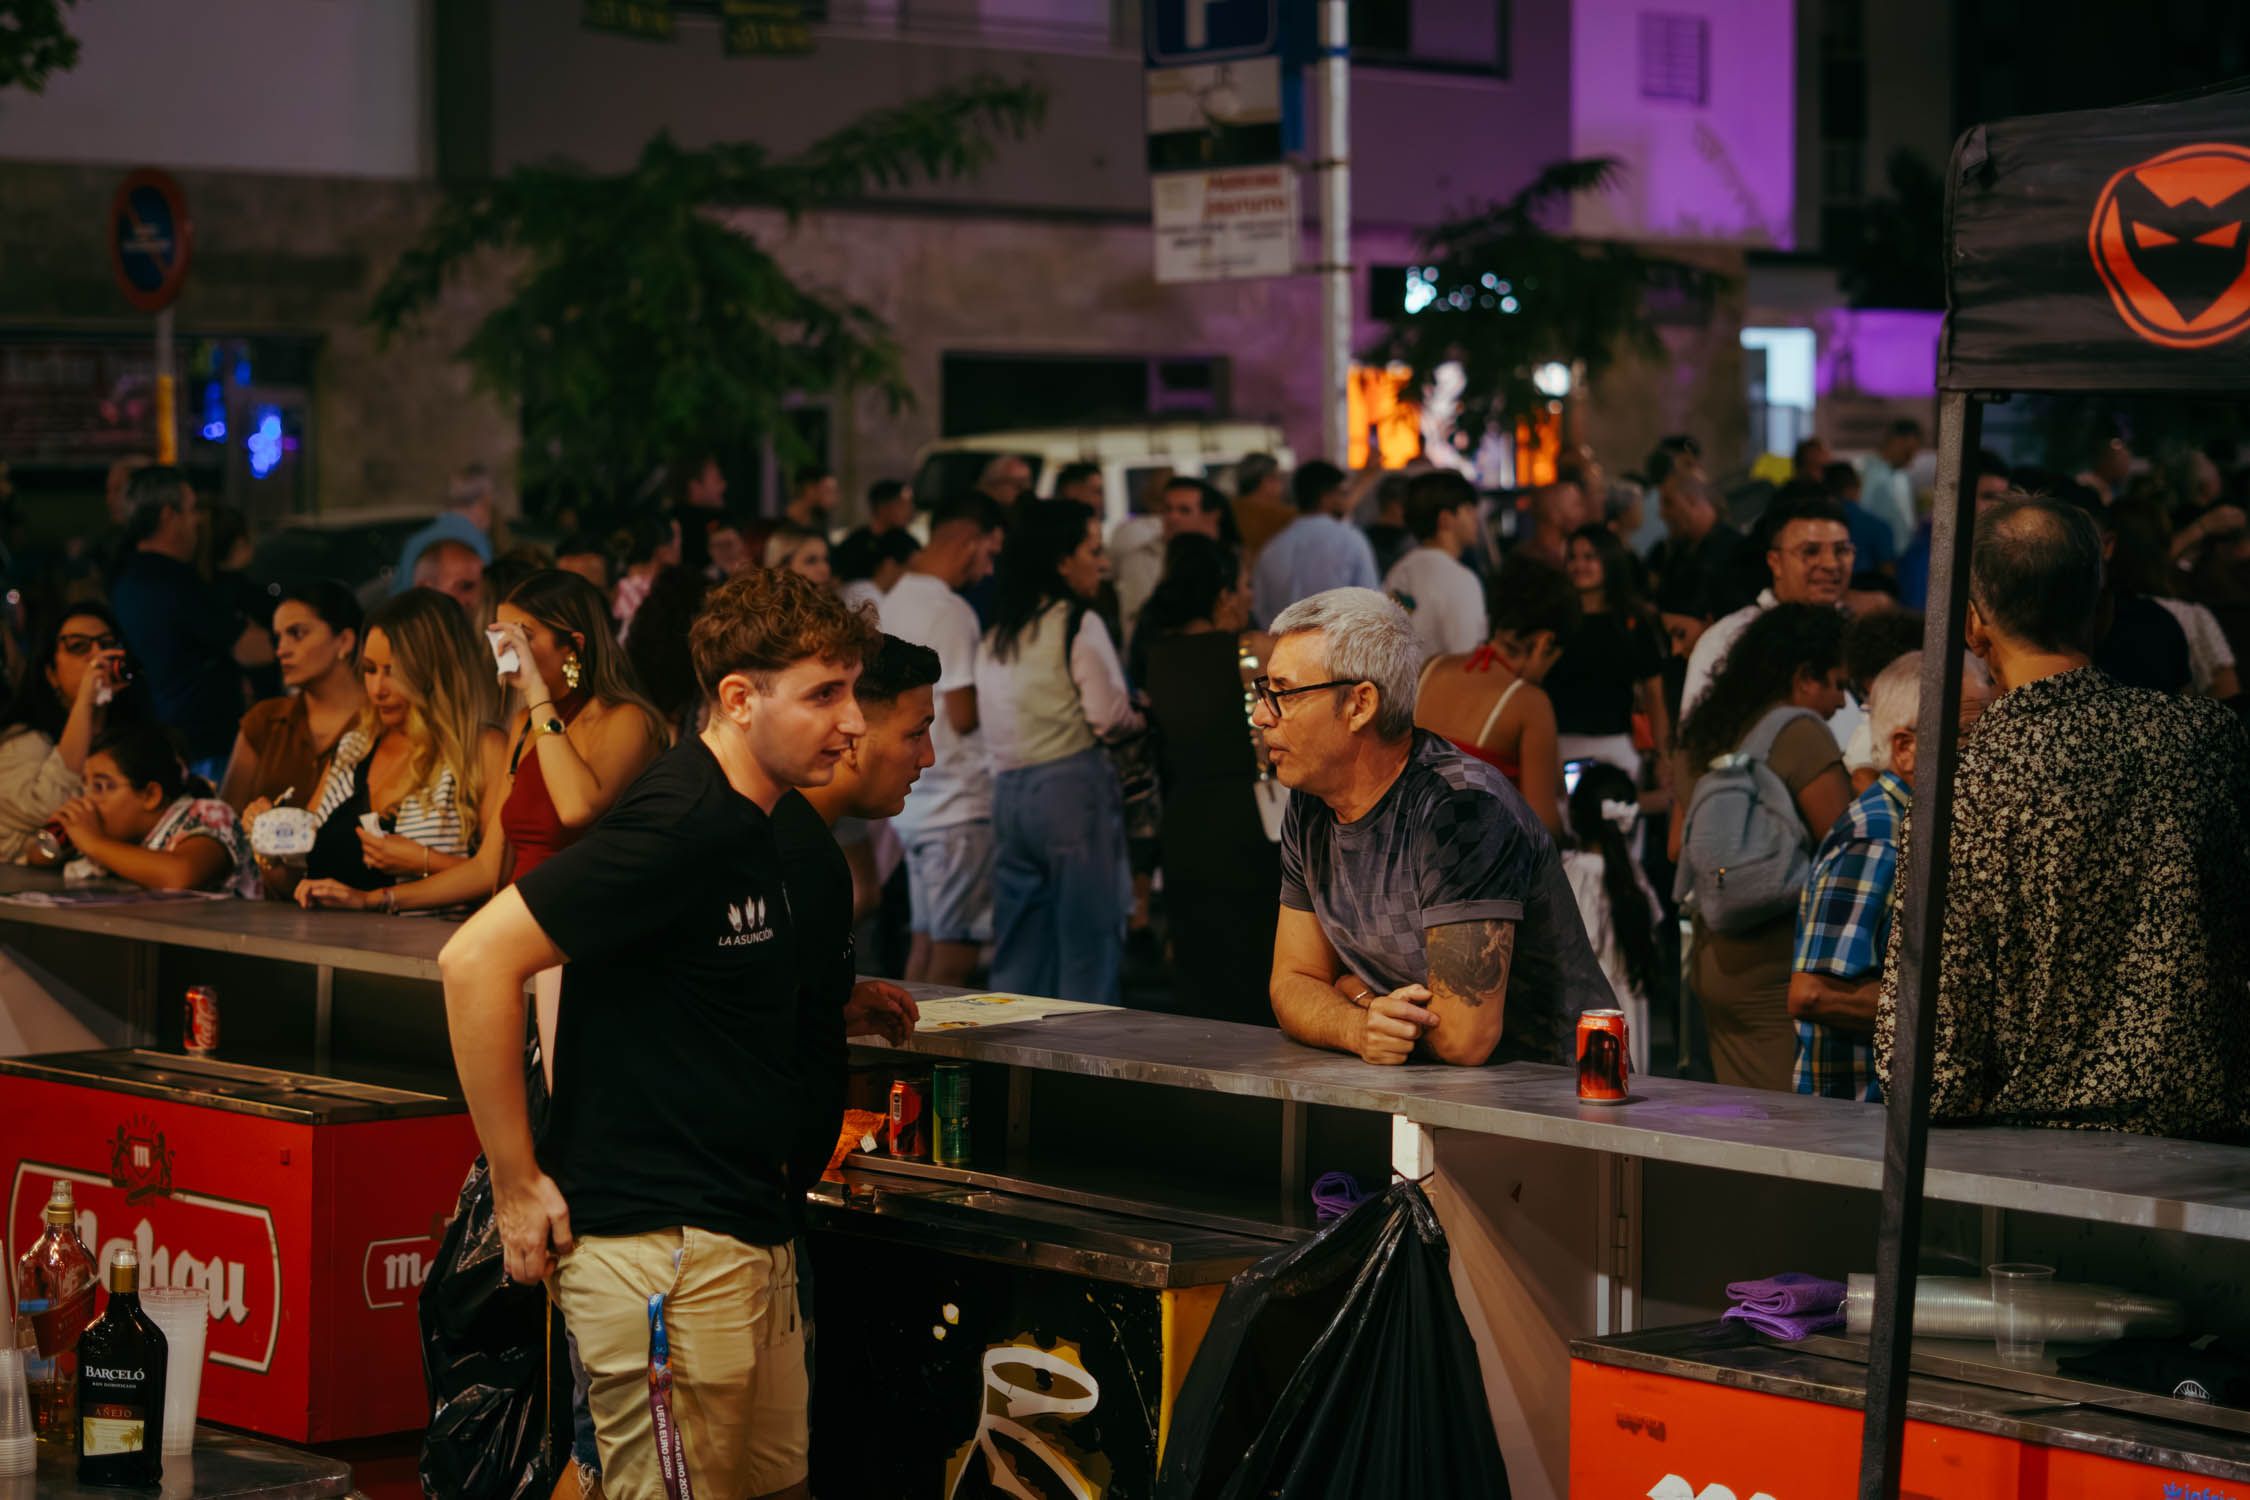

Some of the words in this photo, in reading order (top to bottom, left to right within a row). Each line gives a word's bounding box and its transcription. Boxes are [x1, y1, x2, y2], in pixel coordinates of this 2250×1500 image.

[718, 935, 732, 946] LA
[85, 1365, 145, 1381] BARCELÓ
[95, 1406, 133, 1418] AÑEJO
[655, 1405, 666, 1430] UEFA
[659, 1430, 669, 1455] EURO
[662, 1455, 672, 1479] 2020
[675, 1453, 686, 1478] EURO
